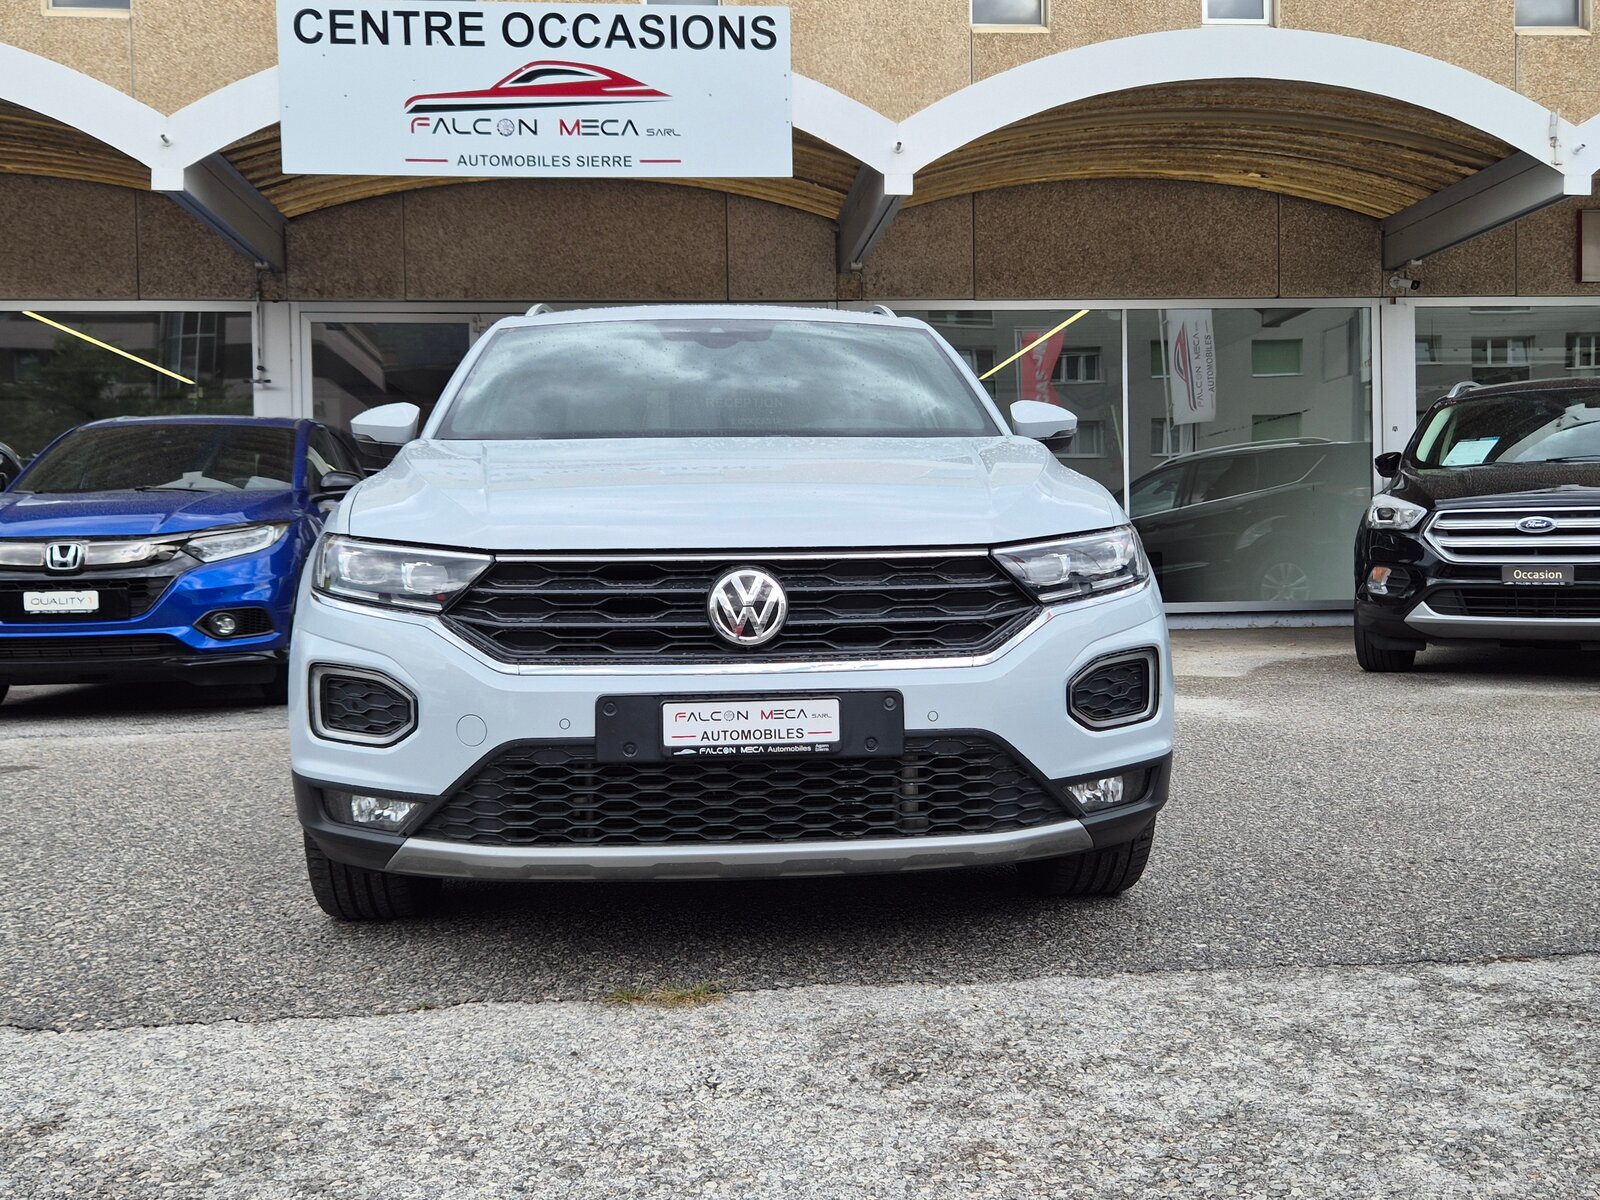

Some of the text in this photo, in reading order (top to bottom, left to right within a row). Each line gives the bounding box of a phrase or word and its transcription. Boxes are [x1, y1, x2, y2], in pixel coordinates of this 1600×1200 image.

[293, 8, 778, 50] CENTRE OCCASIONS
[410, 117, 681, 137] FALCON MECA SARL
[457, 154, 633, 168] AUTOMOBILES SIERRE
[1204, 334, 1215, 393] AUTOMOBILES
[1513, 569, 1563, 580] Occasion
[30, 597, 85, 605] QUALITY
[674, 710, 749, 722] FALCON
[760, 708, 808, 720] MECA
[700, 727, 805, 742] AUTOMOBILES
[699, 744, 812, 755] FALCON MECA Automobiles
